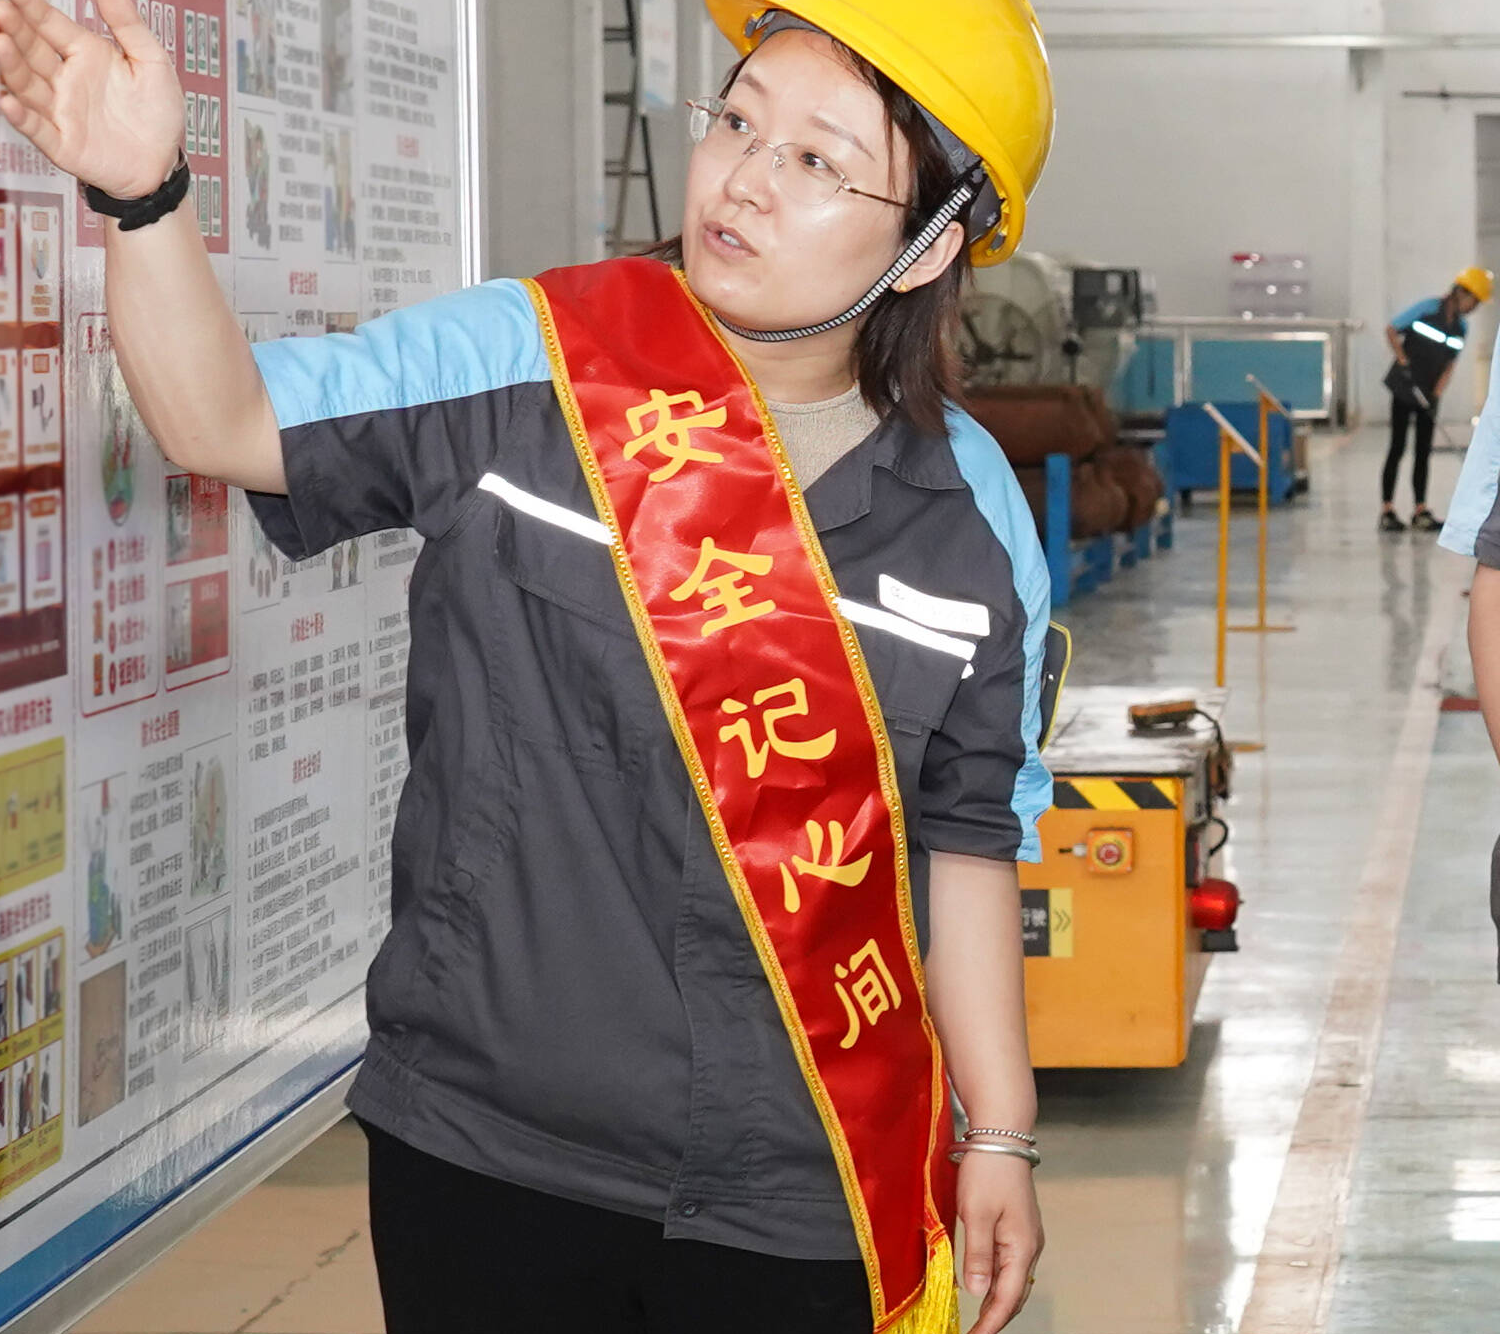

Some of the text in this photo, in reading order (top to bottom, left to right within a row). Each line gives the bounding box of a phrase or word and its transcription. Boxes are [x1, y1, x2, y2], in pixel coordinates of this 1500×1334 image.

[623, 388, 904, 1049] 安全记心间
